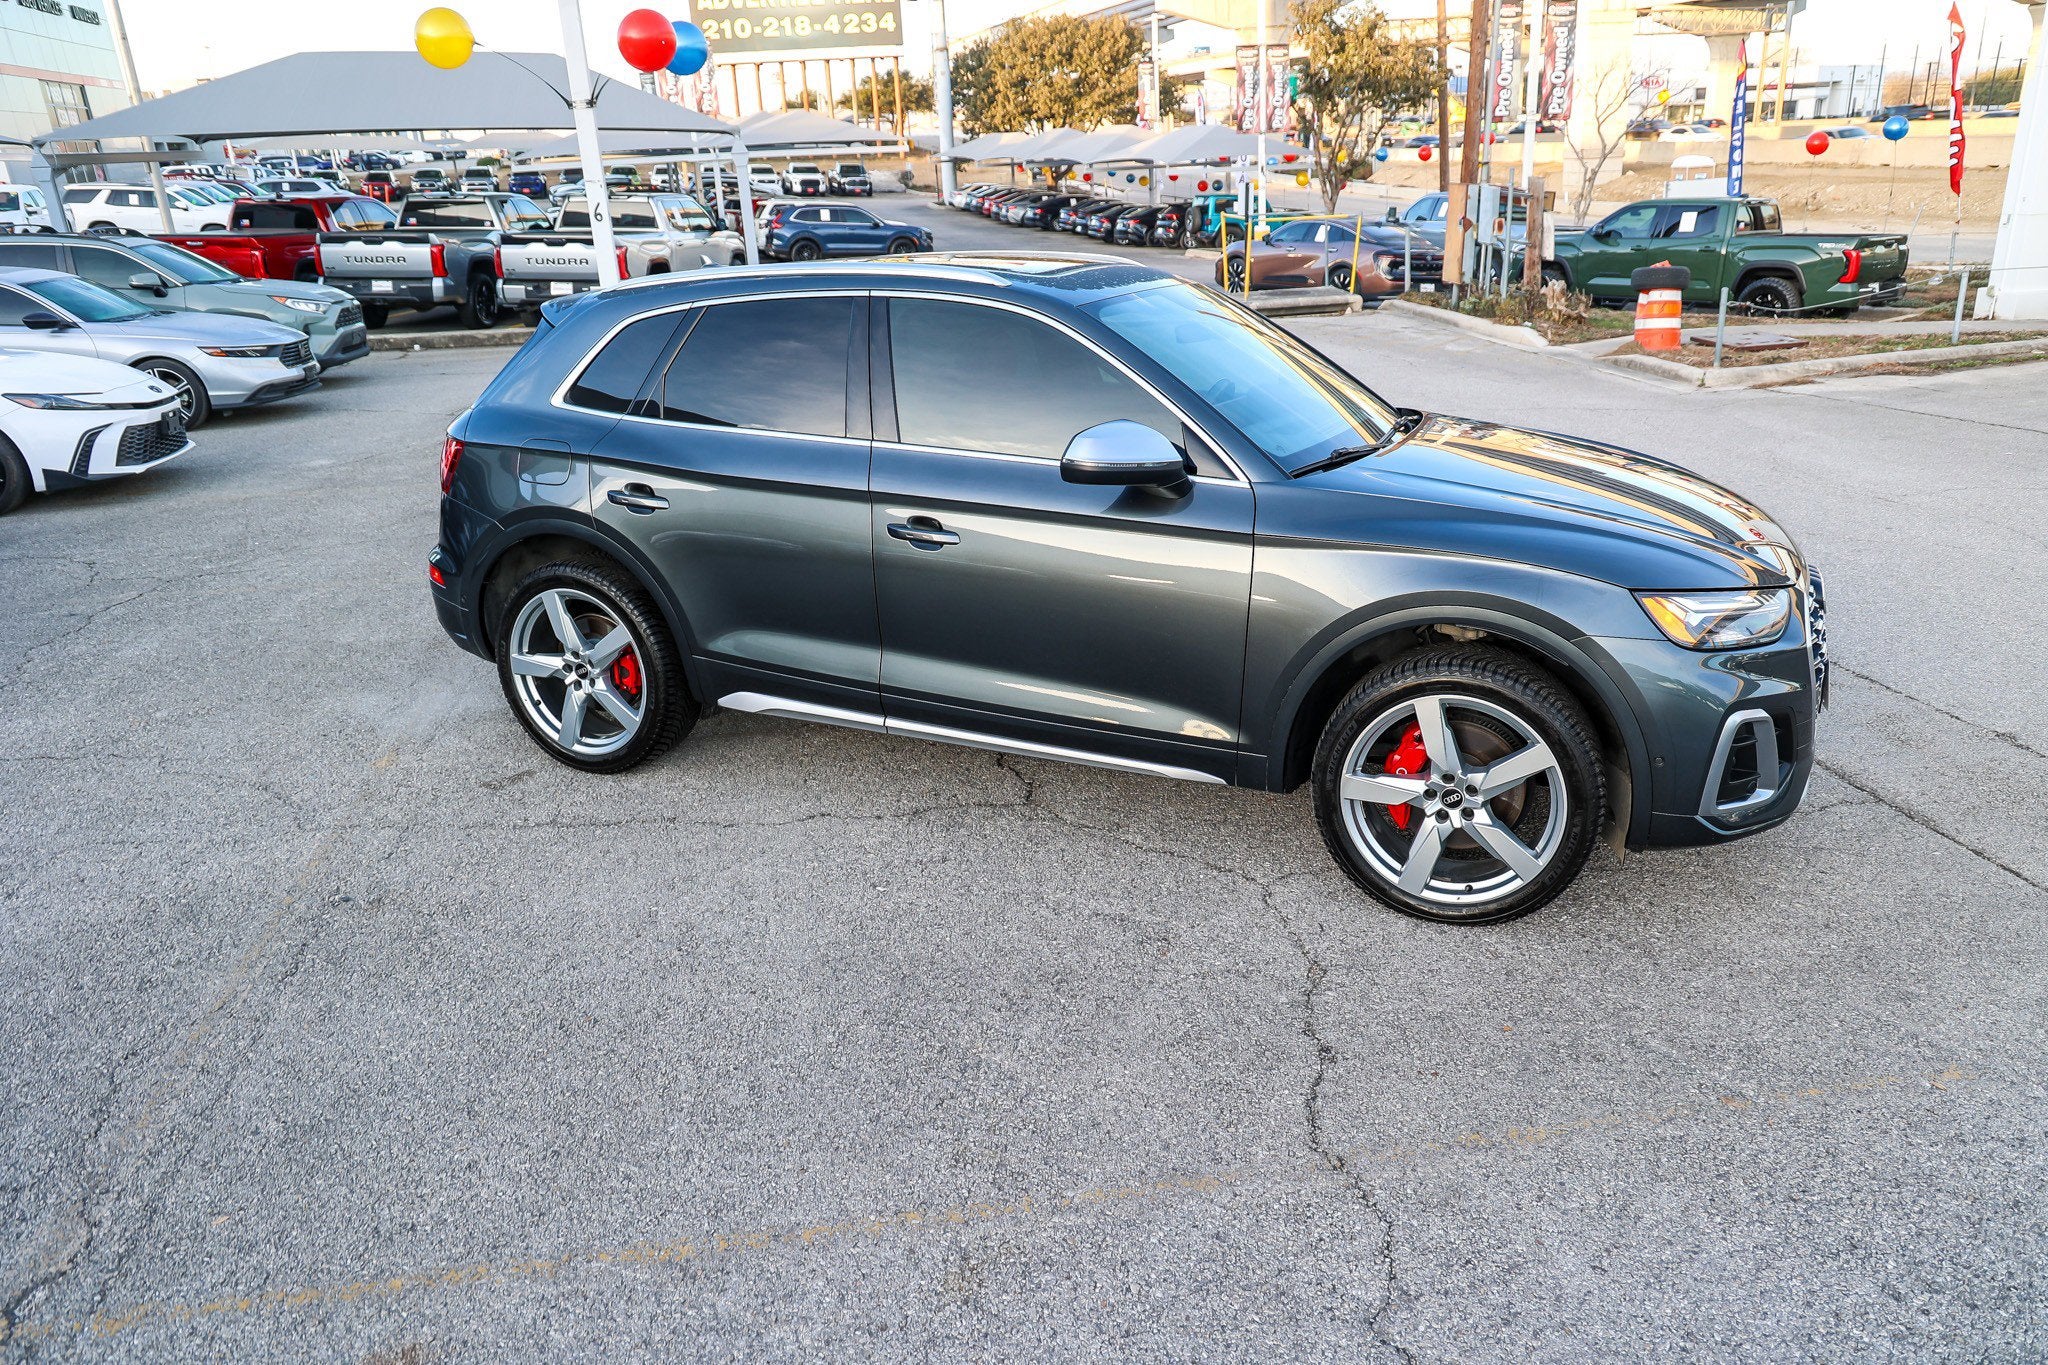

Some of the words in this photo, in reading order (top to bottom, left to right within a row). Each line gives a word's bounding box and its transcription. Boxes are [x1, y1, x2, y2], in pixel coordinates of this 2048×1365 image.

[701, 11, 896, 40] 210-218-4234
[1497, 28, 1515, 87] Owned
[1550, 26, 1569, 84] Owned
[1242, 65, 1254, 108] Owned
[1271, 64, 1283, 107] Owned
[1495, 88, 1512, 116] Pre
[1548, 86, 1565, 115] Pre
[1242, 108, 1254, 130] Pre
[1271, 107, 1283, 129] Pre
[594, 202, 604, 222] 6
[344, 255, 407, 264] TUNDRA
[525, 257, 589, 266] TUNDRA
